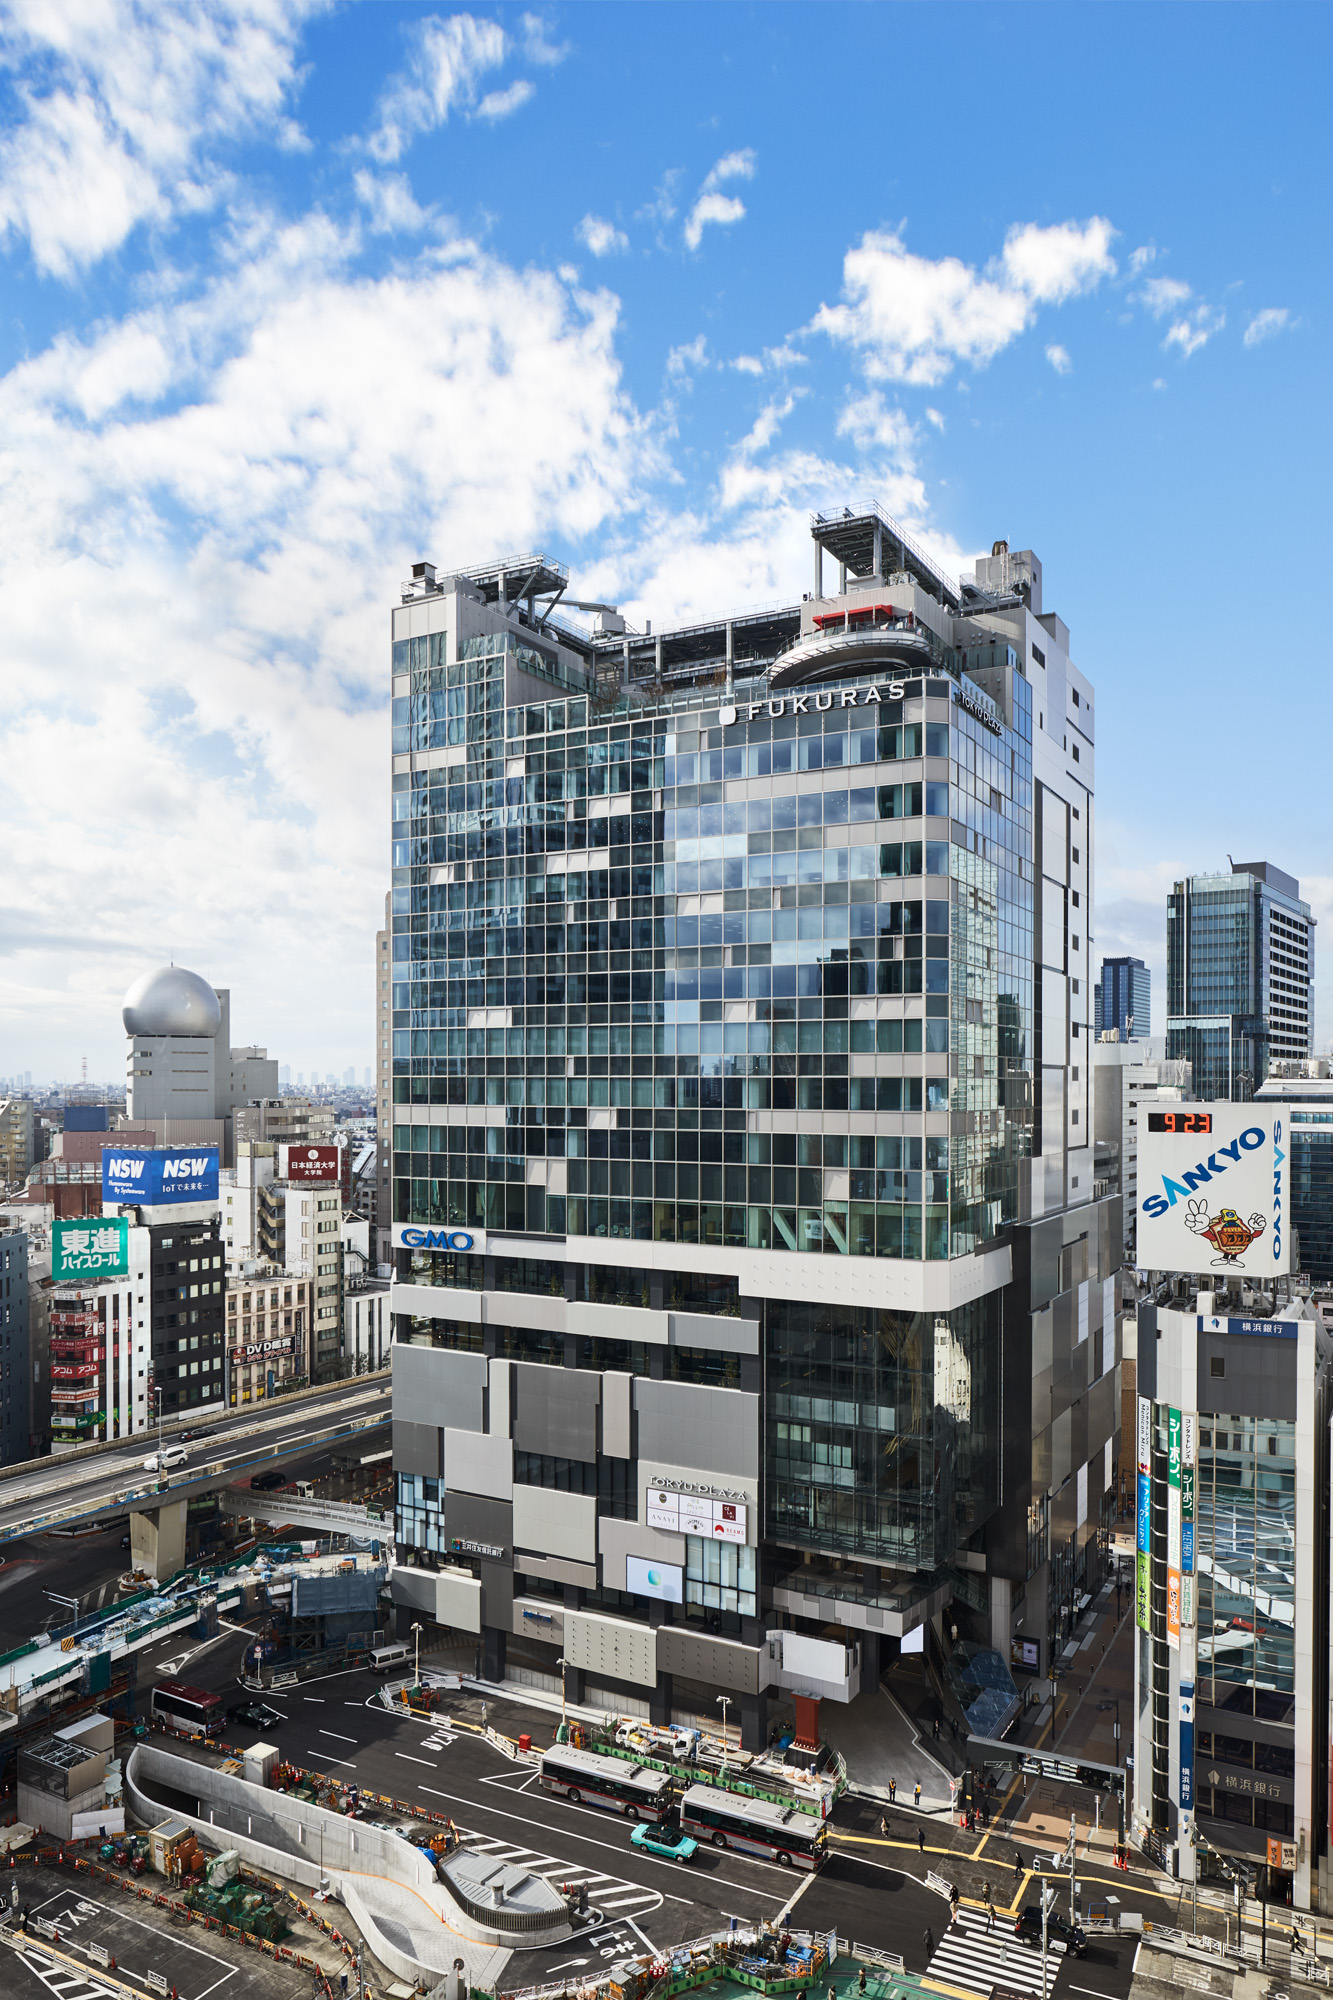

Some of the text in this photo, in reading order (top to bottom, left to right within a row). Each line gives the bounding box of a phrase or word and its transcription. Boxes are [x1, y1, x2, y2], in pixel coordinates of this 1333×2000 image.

[748, 682, 905, 721] FUKURAS
[108, 1159, 145, 1179] NSW
[162, 1158, 209, 1179] NSW
[291, 1161, 336, 1169] 日本経済大学
[1142, 1127, 1266, 1218] SANKYO
[1273, 1119, 1286, 1261] SANKYO
[61, 1227, 120, 1256] 東進
[400, 1228, 474, 1251] GMO
[61, 1253, 120, 1270] ハイスクール
[1242, 1322, 1283, 1334] 横浜銀行
[53, 1366, 73, 1374] アコム
[78, 1364, 97, 1374] アコム
[648, 1475, 747, 1501] TOKYU PLAZA
[652, 1514, 675, 1523] ANAYI
[726, 1528, 744, 1536] BEAMS
[1181, 1767, 1190, 1801] 横浜銀行
[1225, 1775, 1281, 1798] 横浜銀行
